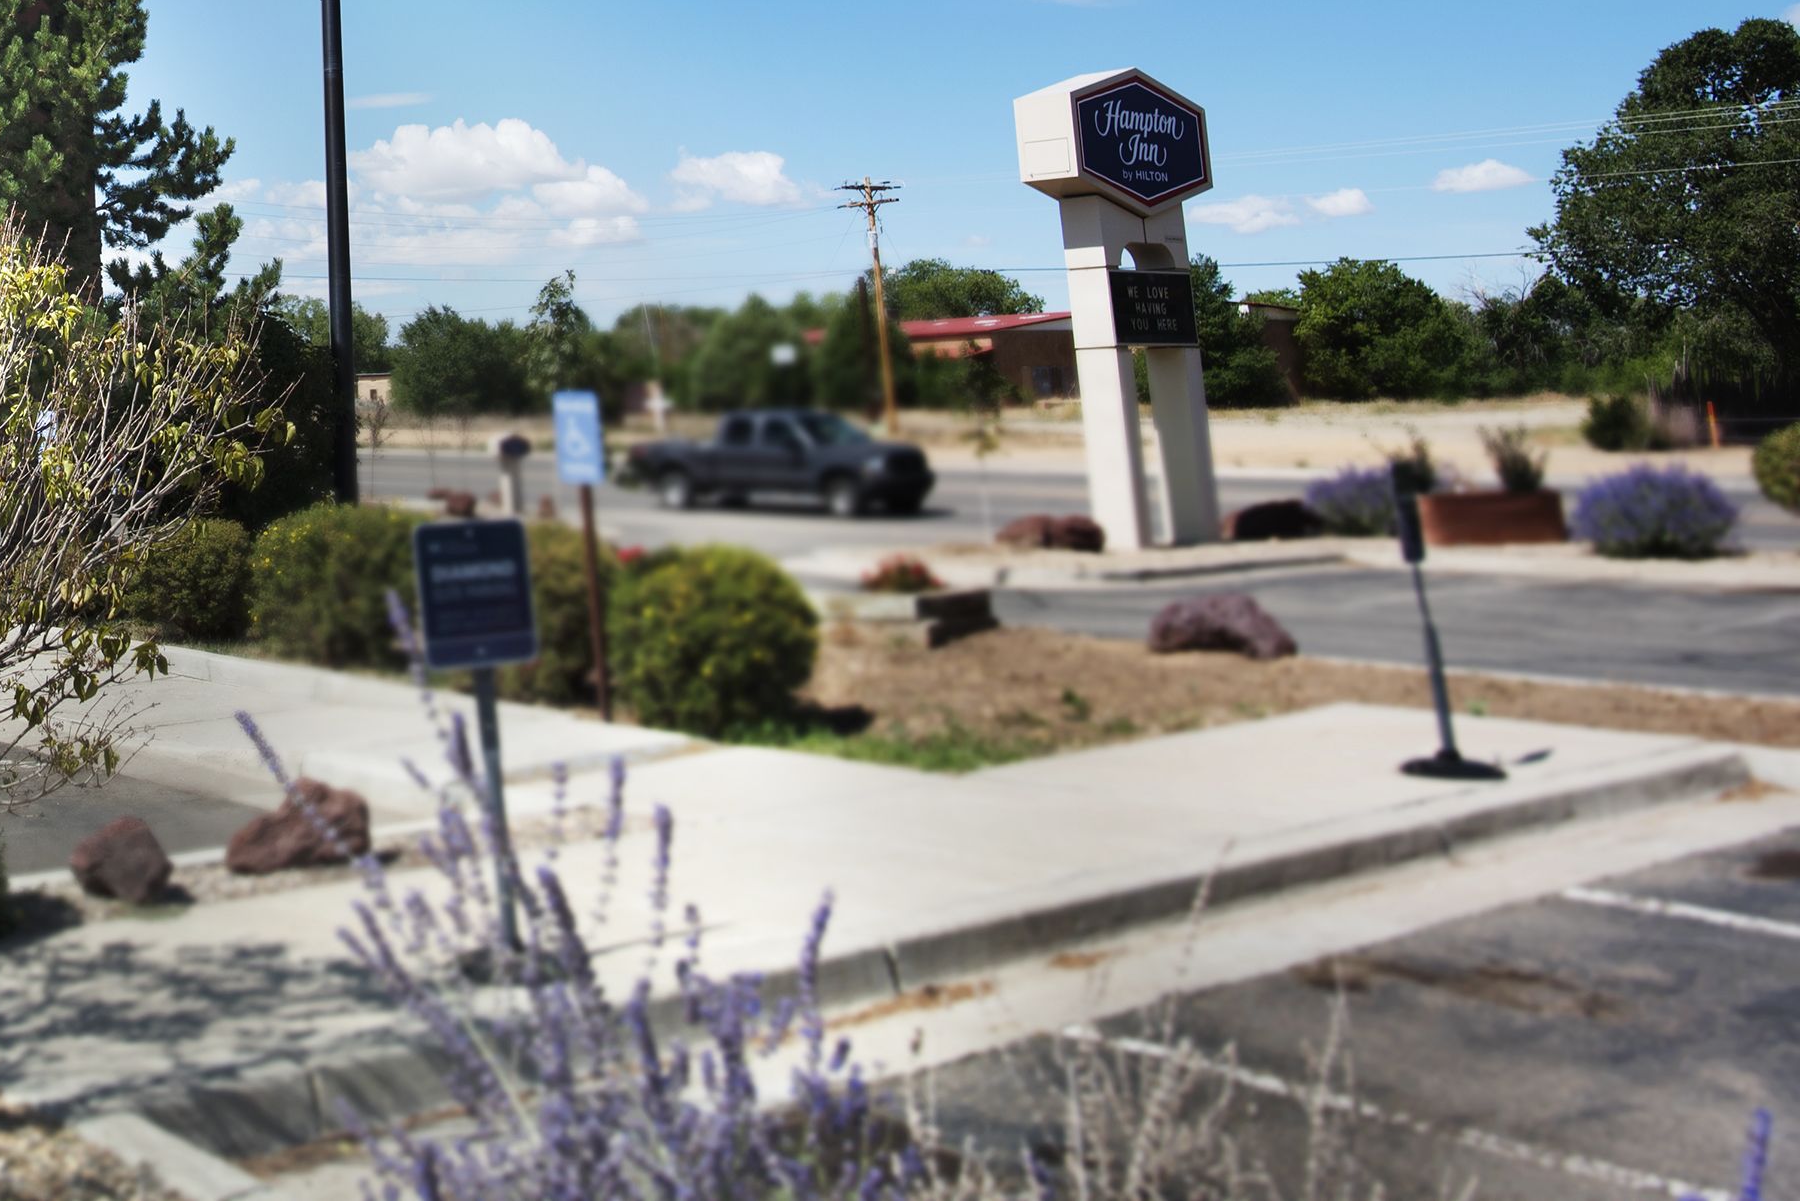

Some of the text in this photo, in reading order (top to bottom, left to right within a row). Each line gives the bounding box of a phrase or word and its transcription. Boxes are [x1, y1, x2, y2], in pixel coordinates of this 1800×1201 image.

[1094, 100, 1184, 140] Hampton
[1119, 134, 1167, 167] Inn
[1122, 169, 1169, 183] by HILTON
[1127, 285, 1169, 300] WE LOVE
[1135, 302, 1167, 315] HAVING
[1130, 318, 1178, 332] YOU HERE
